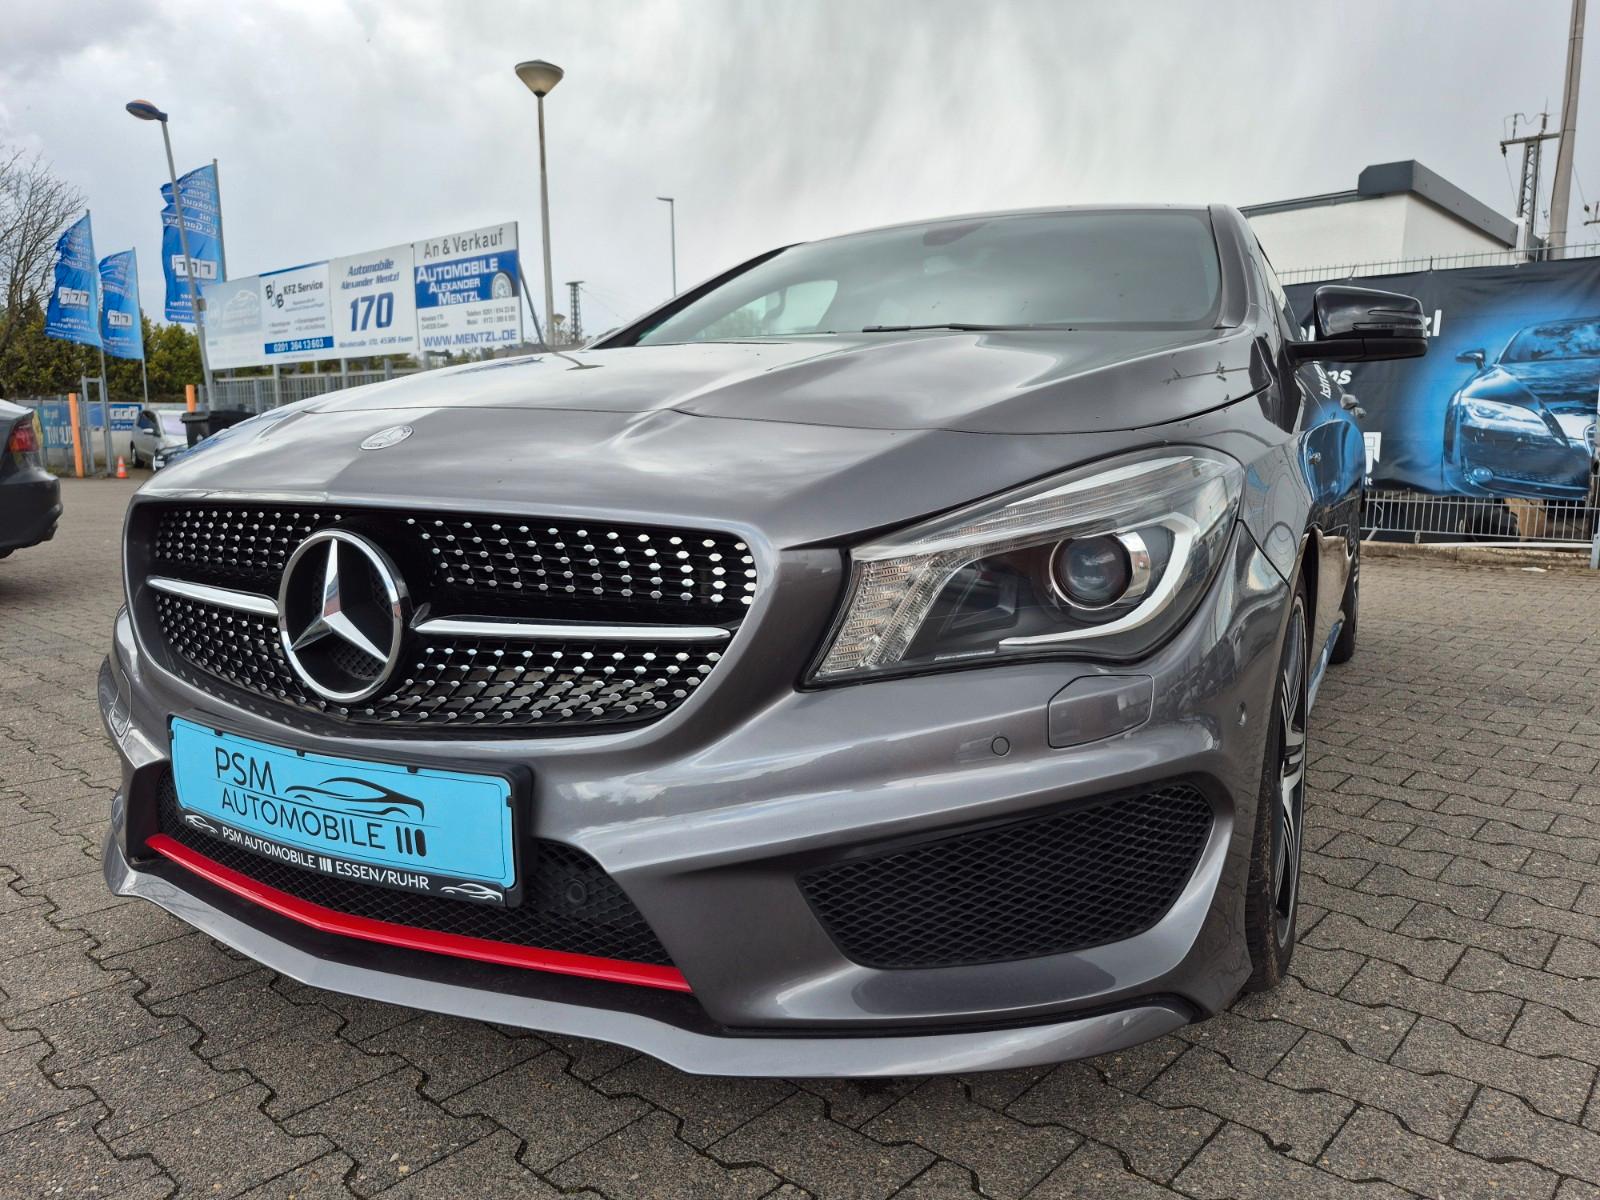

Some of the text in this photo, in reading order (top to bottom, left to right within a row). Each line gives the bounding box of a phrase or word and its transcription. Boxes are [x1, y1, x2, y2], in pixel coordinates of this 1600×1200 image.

[424, 228, 503, 259] An & Verkauf
[347, 258, 394, 276] Automobile
[416, 258, 498, 284] AUTOMOBILE
[283, 280, 324, 296] KFZ Service
[341, 272, 400, 290] Alexander Mentzl
[428, 278, 480, 294] ALEXANDER
[438, 290, 481, 305] MENTZL
[350, 291, 394, 332] 170
[273, 341, 288, 353] 0201
[423, 329, 517, 347] WWW.MENTZL.DE
[215, 746, 276, 795] PSM
[222, 787, 386, 849] AUTOMOBILE
[222, 826, 430, 890] PSM AUTOMOBILE ESSEN/RUHR
